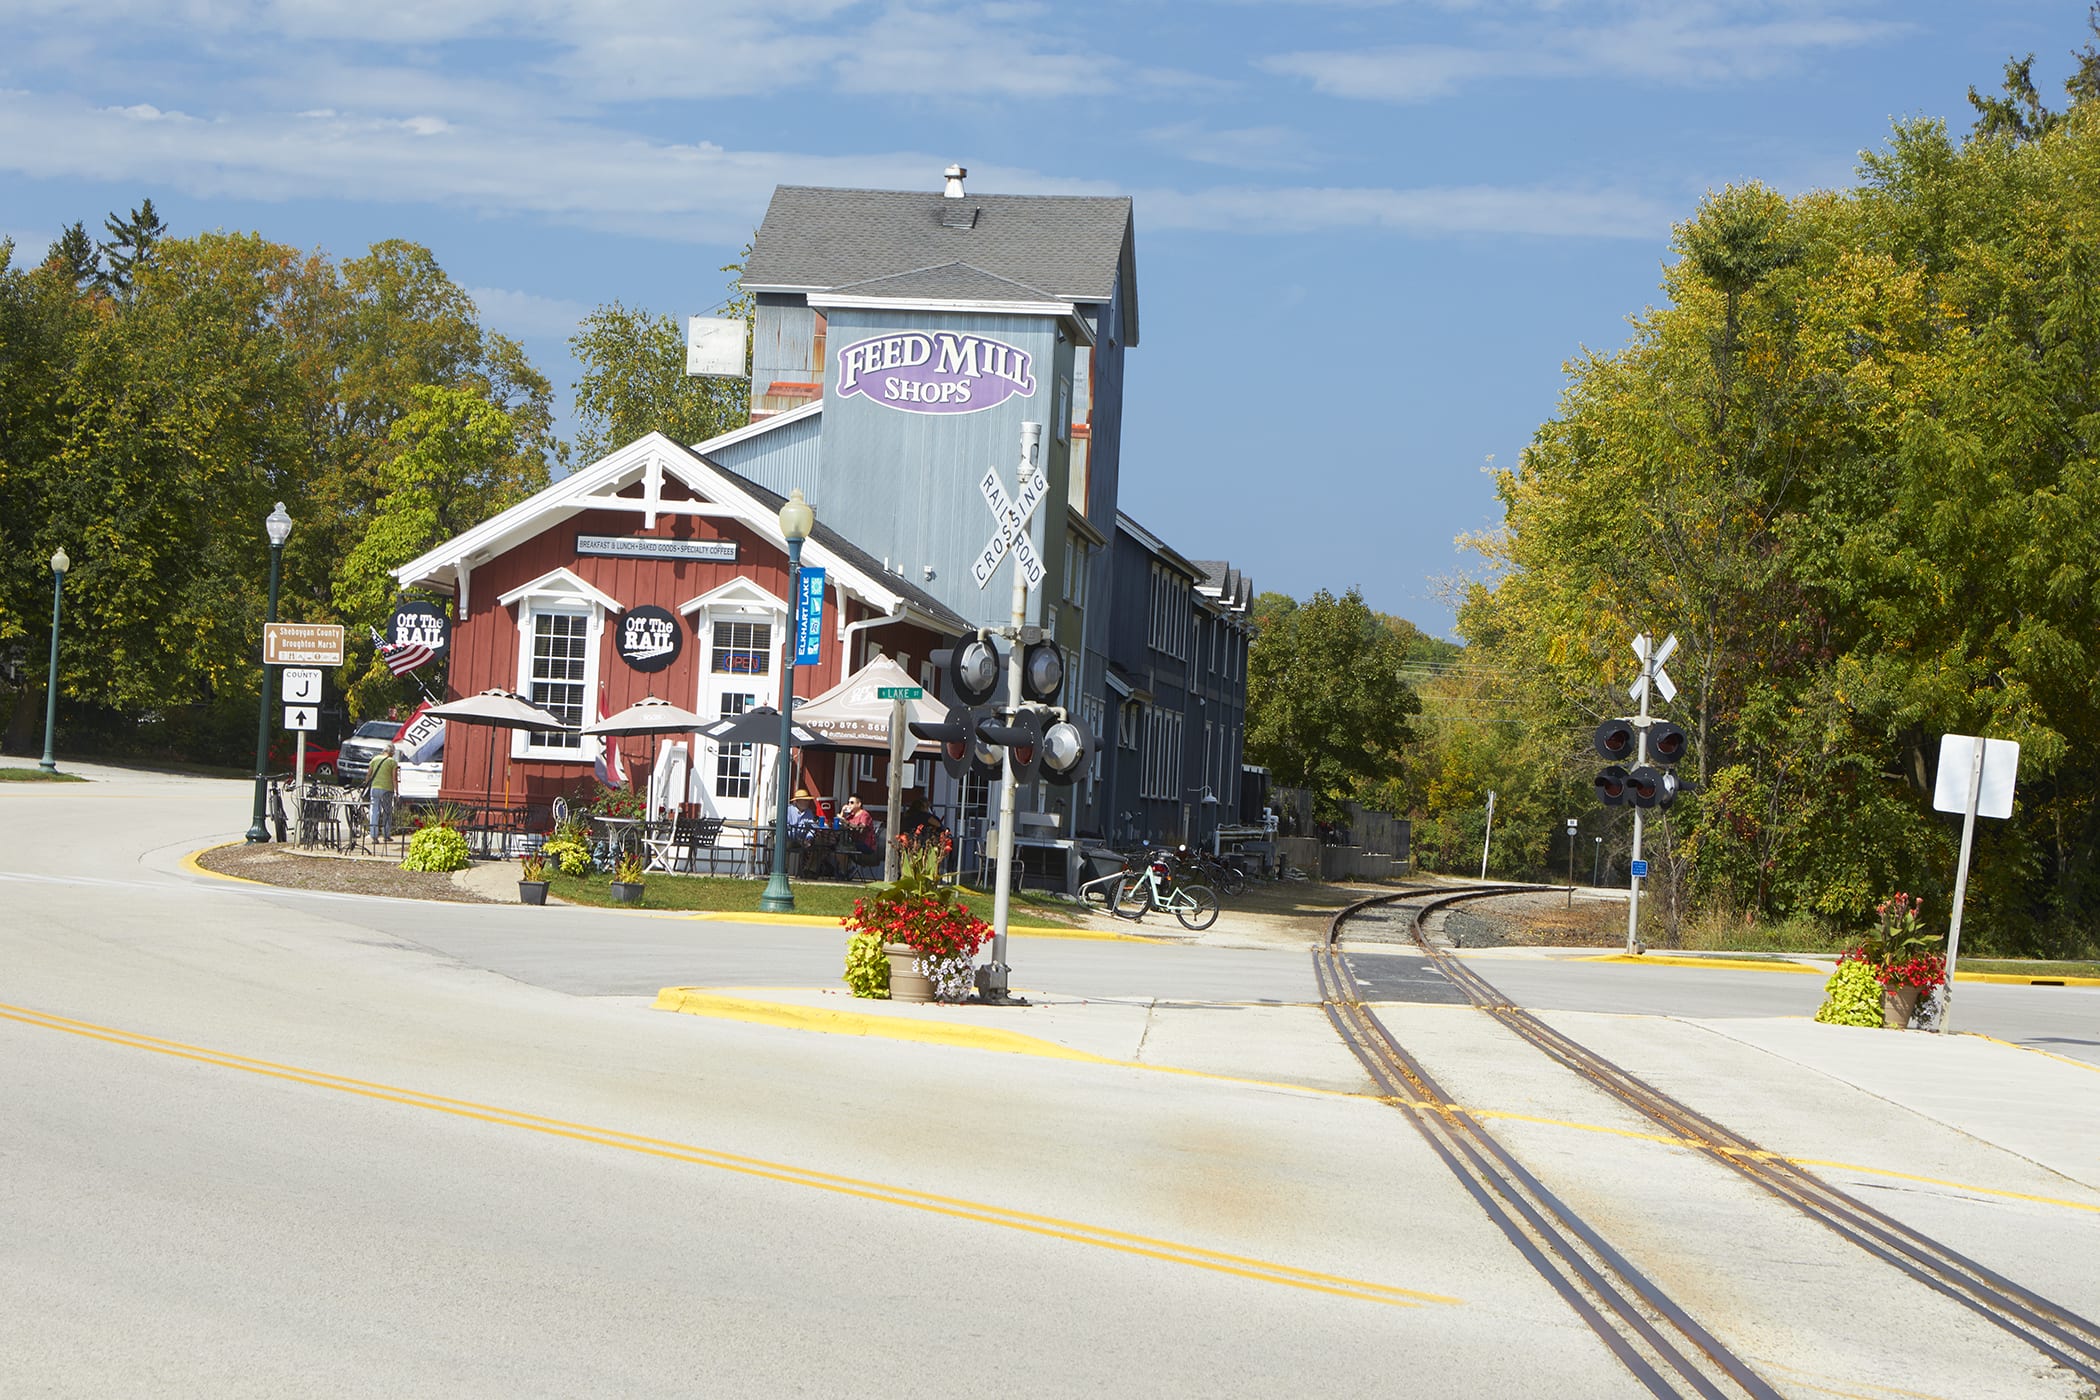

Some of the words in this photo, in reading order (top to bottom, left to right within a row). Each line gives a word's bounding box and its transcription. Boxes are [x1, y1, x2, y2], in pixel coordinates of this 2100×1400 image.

[844, 336, 931, 389] FEED
[933, 336, 1030, 389] MILL
[884, 377, 972, 403] SHOPS
[975, 474, 1045, 582] CROSSING
[578, 539, 611, 549] BREAKFAST
[802, 576, 811, 606] LAKE
[397, 613, 418, 628] Off
[419, 614, 444, 629] The
[625, 617, 645, 632] Off
[649, 618, 674, 633] The
[279, 627, 315, 638] Sheboygan
[316, 628, 340, 639] County
[395, 627, 445, 647] RAIL
[798, 608, 811, 656] ELKHART
[282, 639, 316, 649] Broughton
[317, 640, 337, 649] Marsh
[624, 632, 674, 651] RAIL
[725, 656, 759, 669] OPEN
[295, 680, 309, 698] J
[887, 688, 909, 699] LAKE
